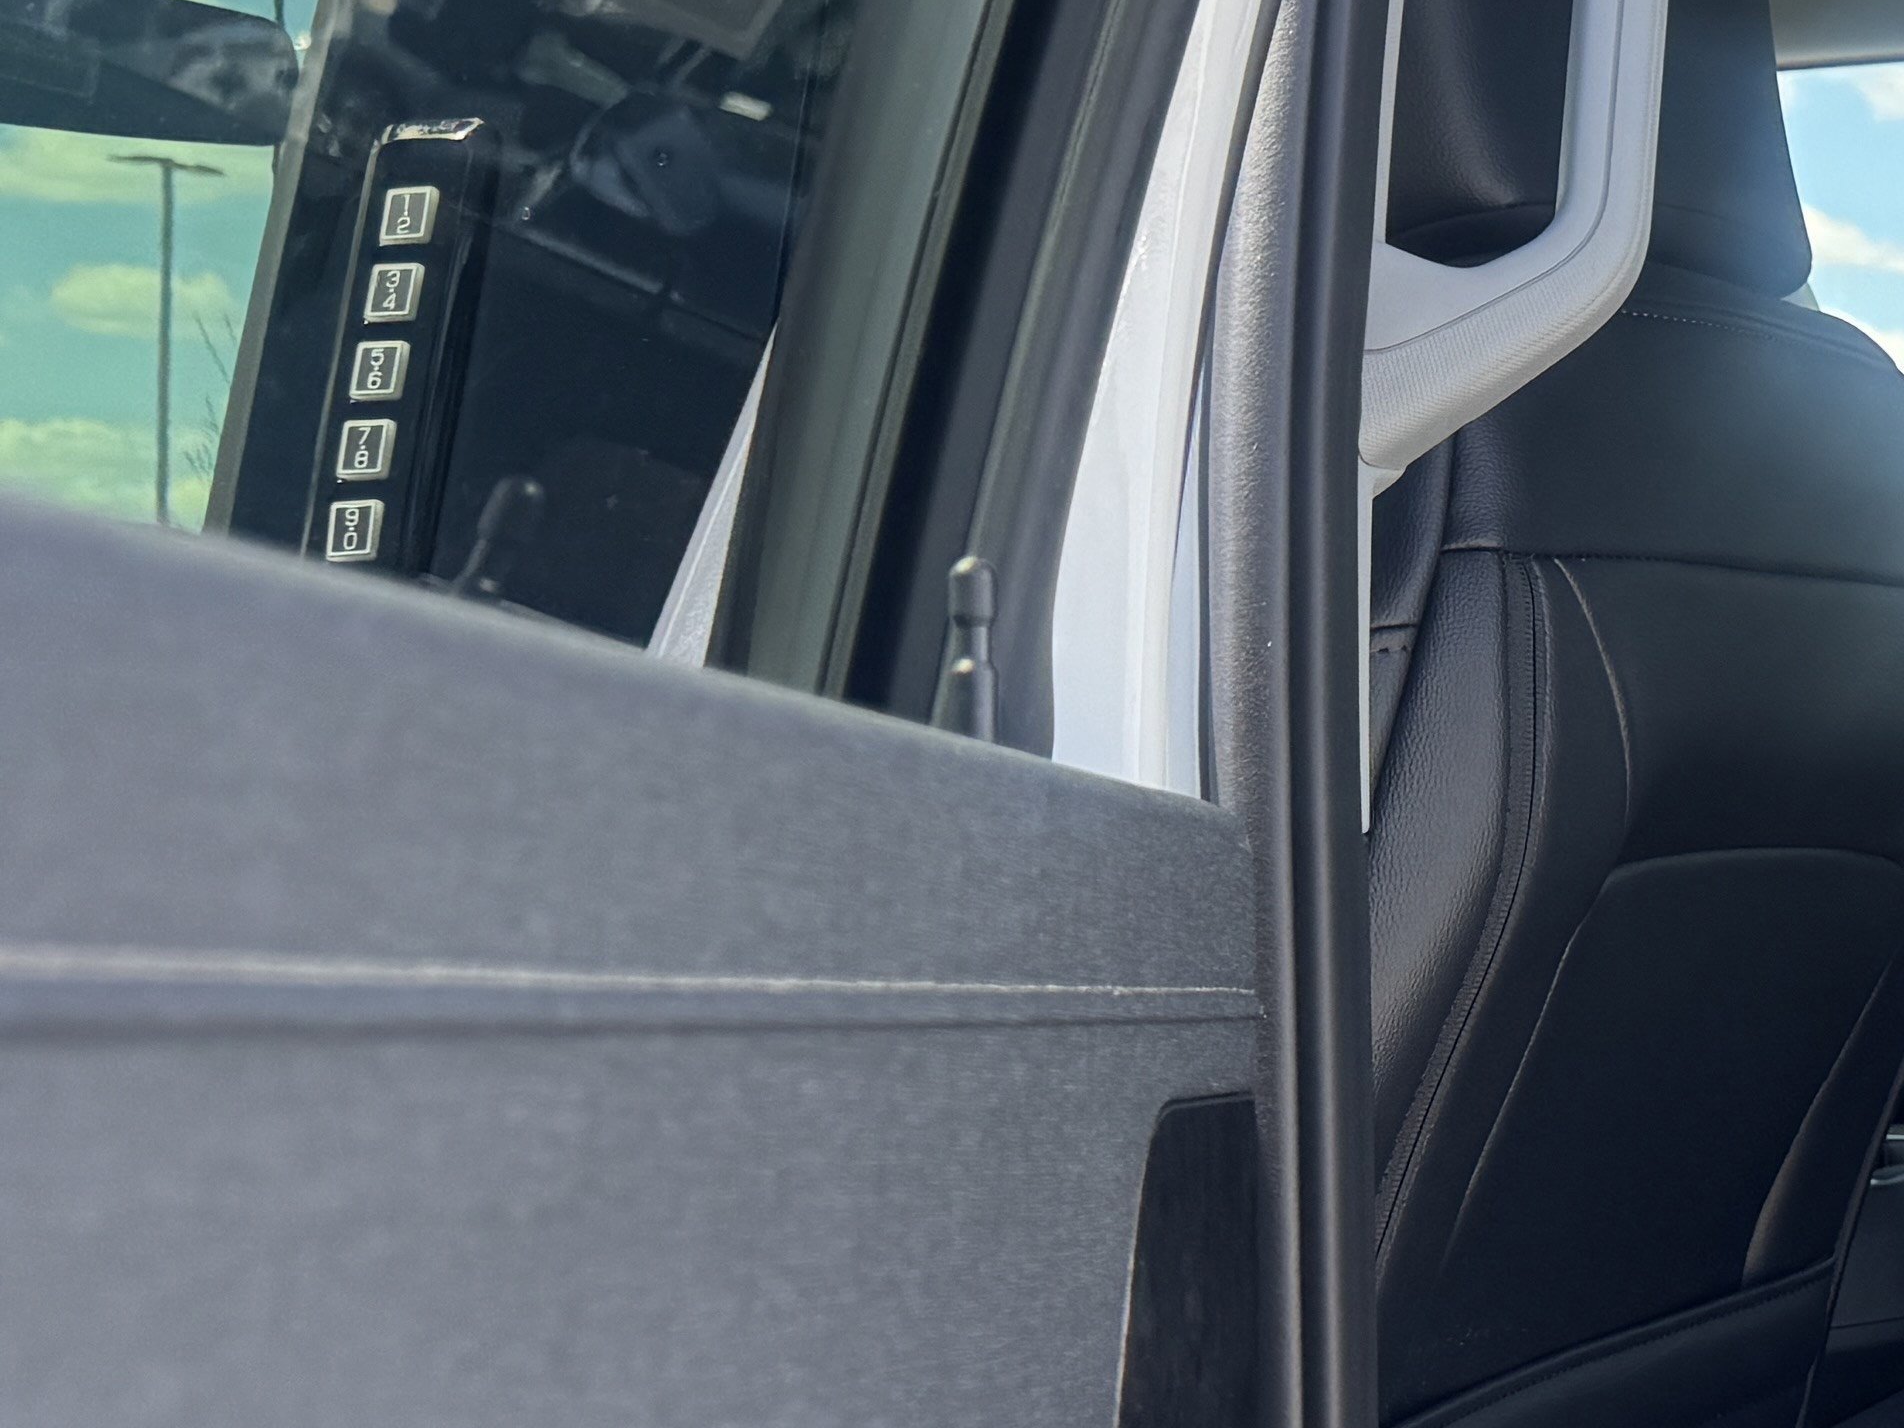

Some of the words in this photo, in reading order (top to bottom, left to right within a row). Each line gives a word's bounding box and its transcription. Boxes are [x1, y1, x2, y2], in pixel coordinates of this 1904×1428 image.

[396, 216, 411, 234] 2
[385, 270, 401, 288] 3
[382, 292, 397, 310] 4
[370, 348, 385, 366] 5
[366, 372, 382, 389] 6
[358, 427, 372, 445] 7
[354, 450, 369, 468] 8
[344, 508, 360, 526] 9
[343, 532, 358, 550] 0
